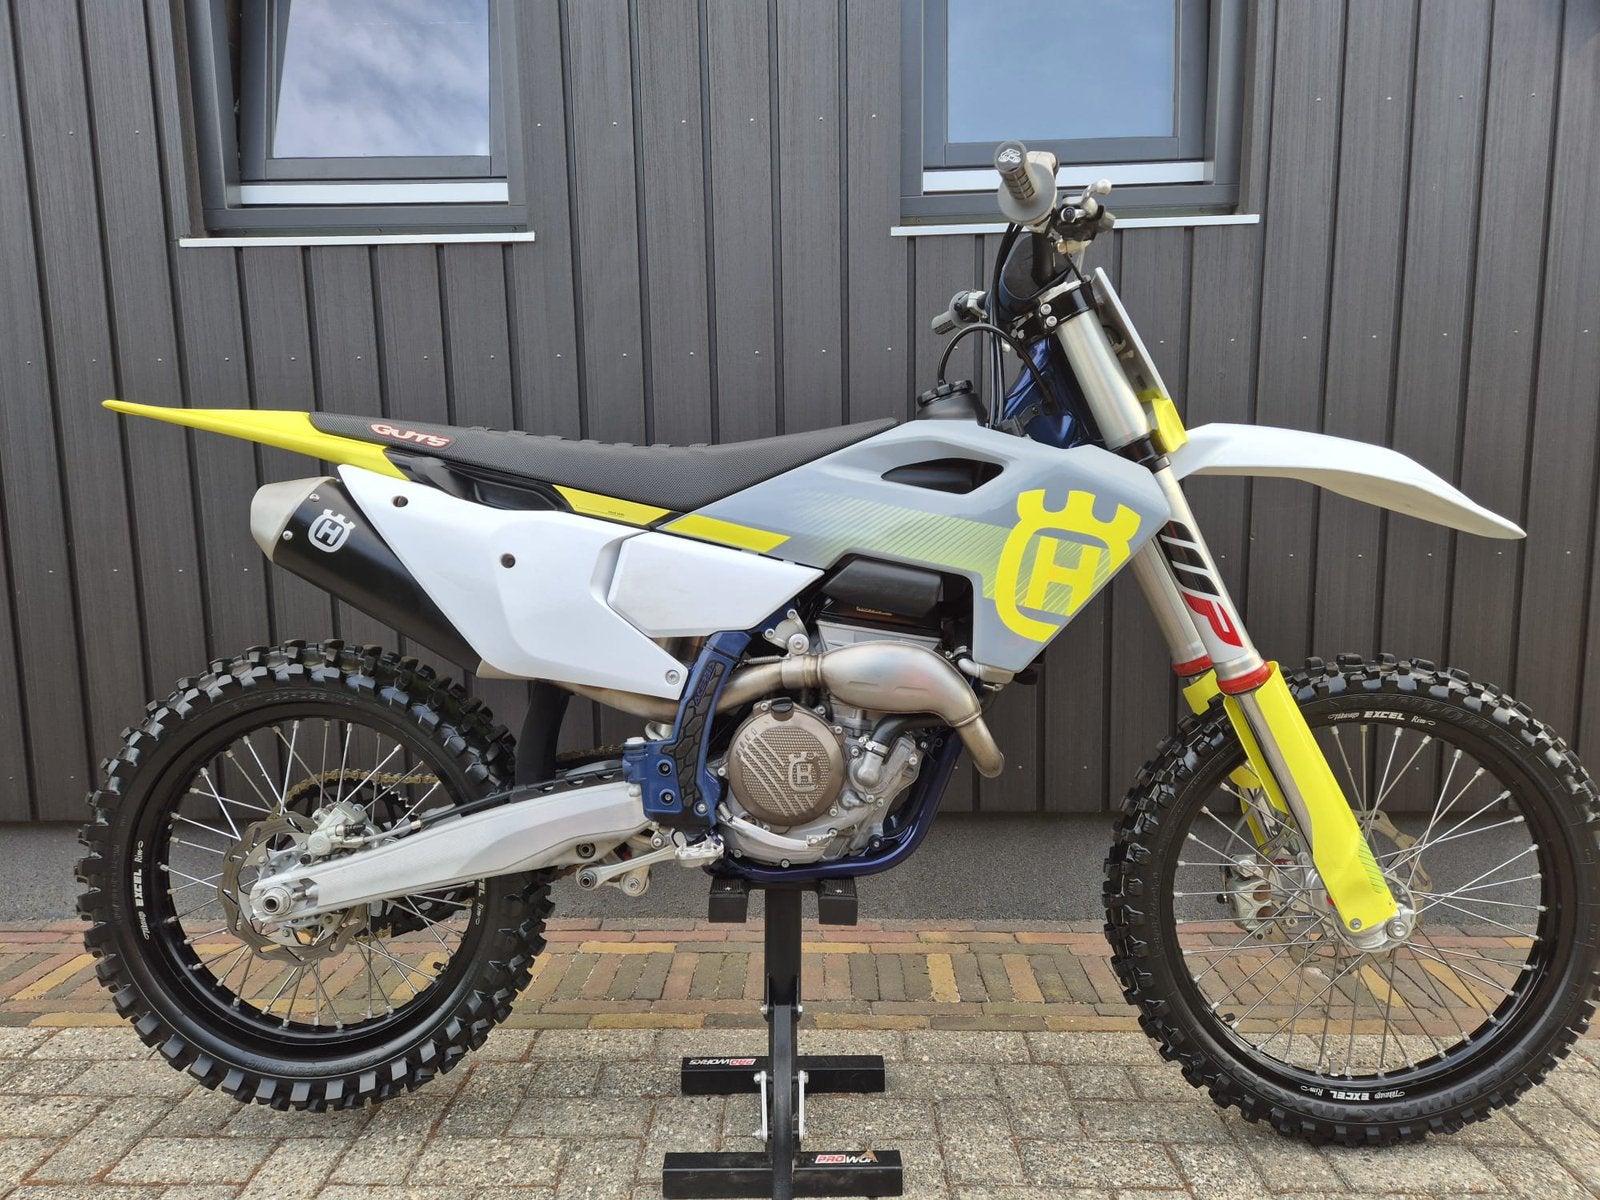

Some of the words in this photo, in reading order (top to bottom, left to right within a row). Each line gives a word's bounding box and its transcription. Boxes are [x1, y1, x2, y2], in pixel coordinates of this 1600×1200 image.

[370, 424, 450, 447] GUTS
[1364, 711, 1405, 720] EXCEL
[133, 868, 144, 907] EXCEL
[1330, 1090, 1370, 1101] EXCEL
